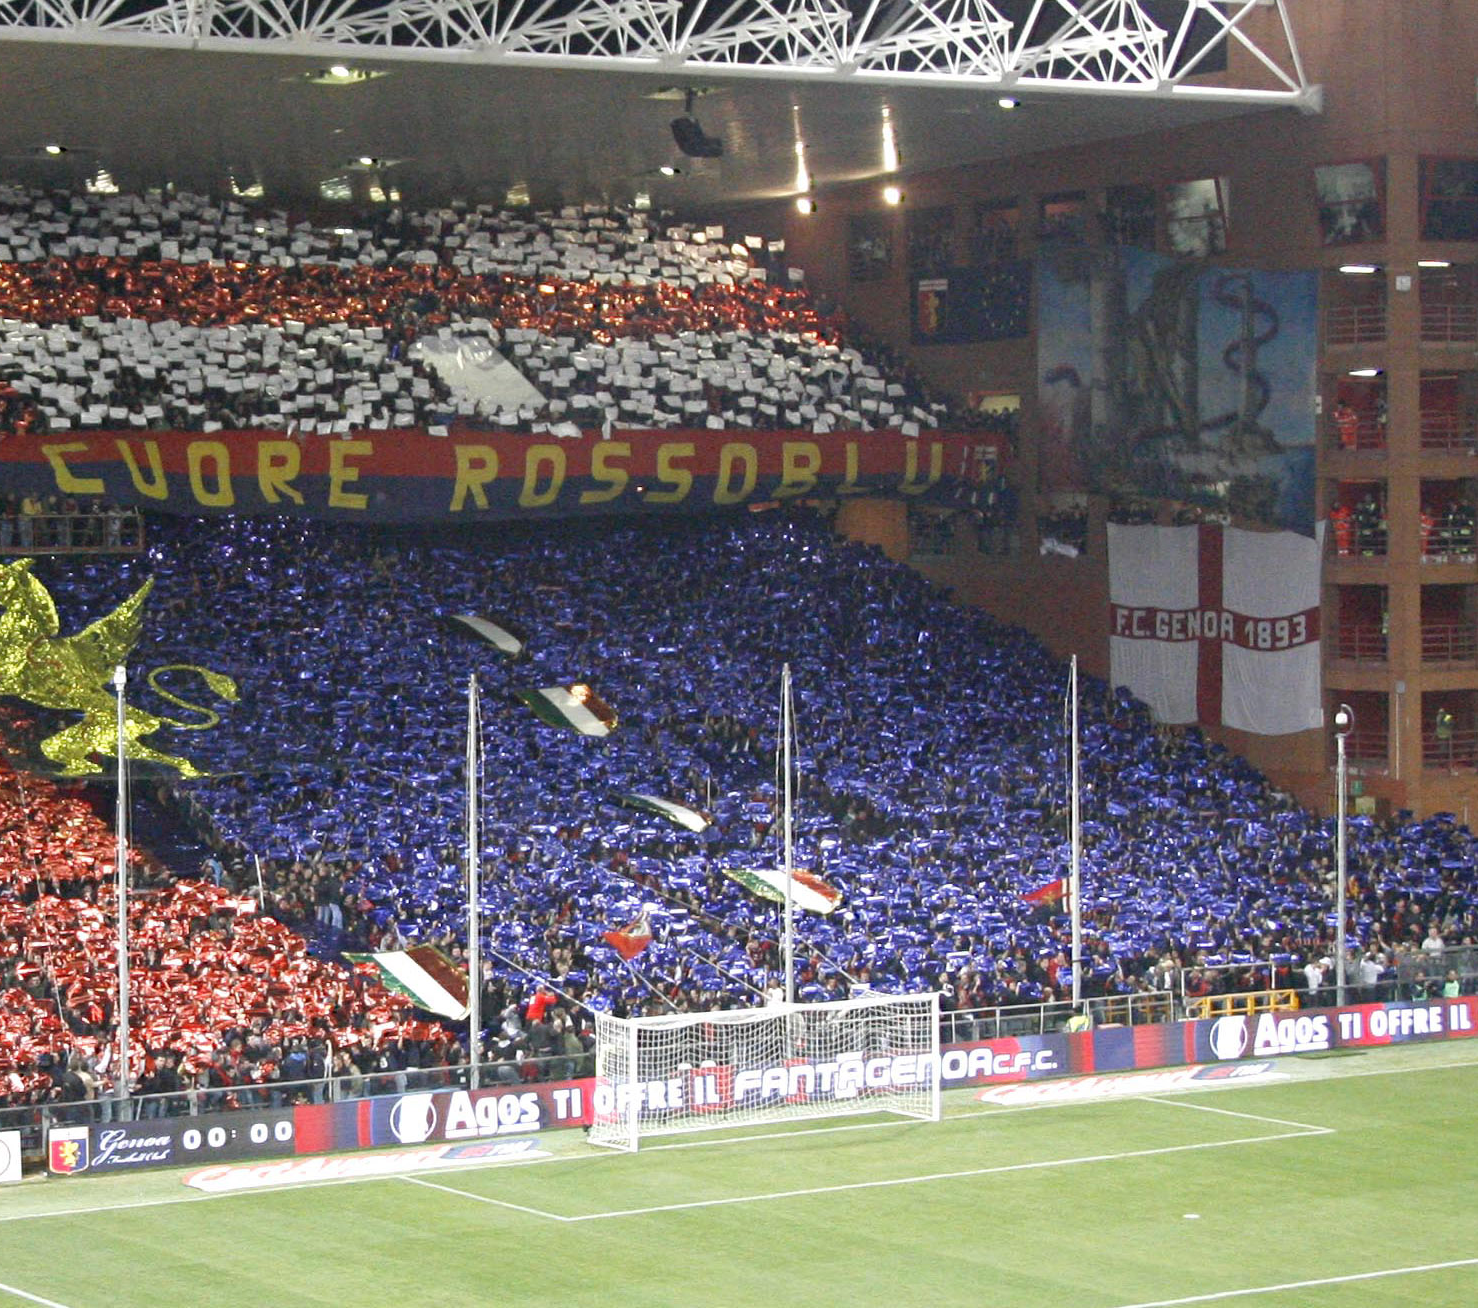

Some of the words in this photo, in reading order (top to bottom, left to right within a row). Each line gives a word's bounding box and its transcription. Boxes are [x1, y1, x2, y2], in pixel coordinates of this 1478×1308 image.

[41, 439, 374, 508] CUORE
[449, 441, 943, 512] ROSSOBLU
[1115, 608, 1151, 636] F.C.
[1155, 611, 1235, 641] GENOA
[1244, 615, 1307, 649] 1893
[1253, 1012, 1329, 1056] Agos
[1339, 1013, 1362, 1040] TI
[1370, 1006, 1442, 1036] OFFRE
[1450, 1004, 1472, 1031] IL
[445, 1090, 540, 1139] Agos
[552, 1088, 582, 1119] TI
[593, 1078, 683, 1115] OFFRE
[694, 1074, 721, 1105] IL
[90, 1129, 171, 1166] Genoa
